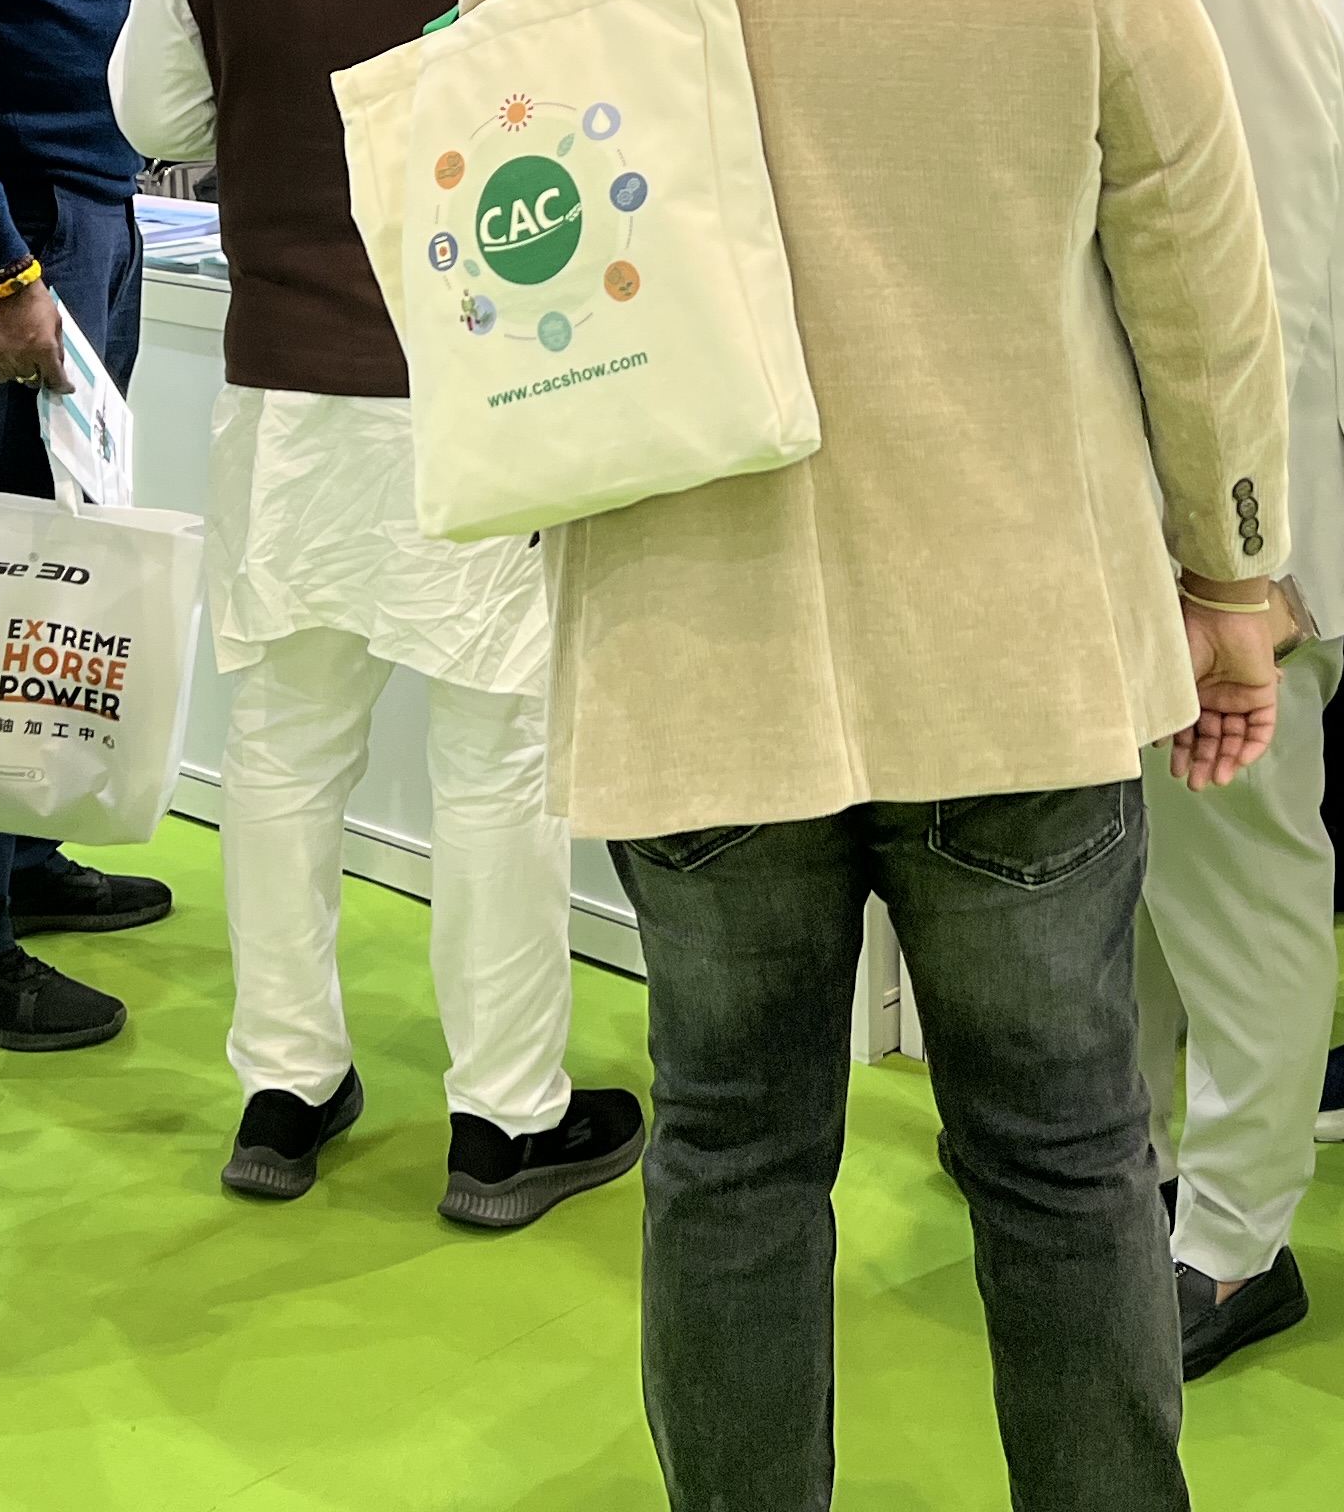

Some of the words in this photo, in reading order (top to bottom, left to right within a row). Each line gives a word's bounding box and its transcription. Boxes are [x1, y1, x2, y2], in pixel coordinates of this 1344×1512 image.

[479, 187, 565, 246] CAC
[486, 350, 649, 409] www.cacshow.com
[35, 562, 91, 586] 3D
[8, 618, 132, 659] EXTREME
[2, 642, 128, 691] HORSE
